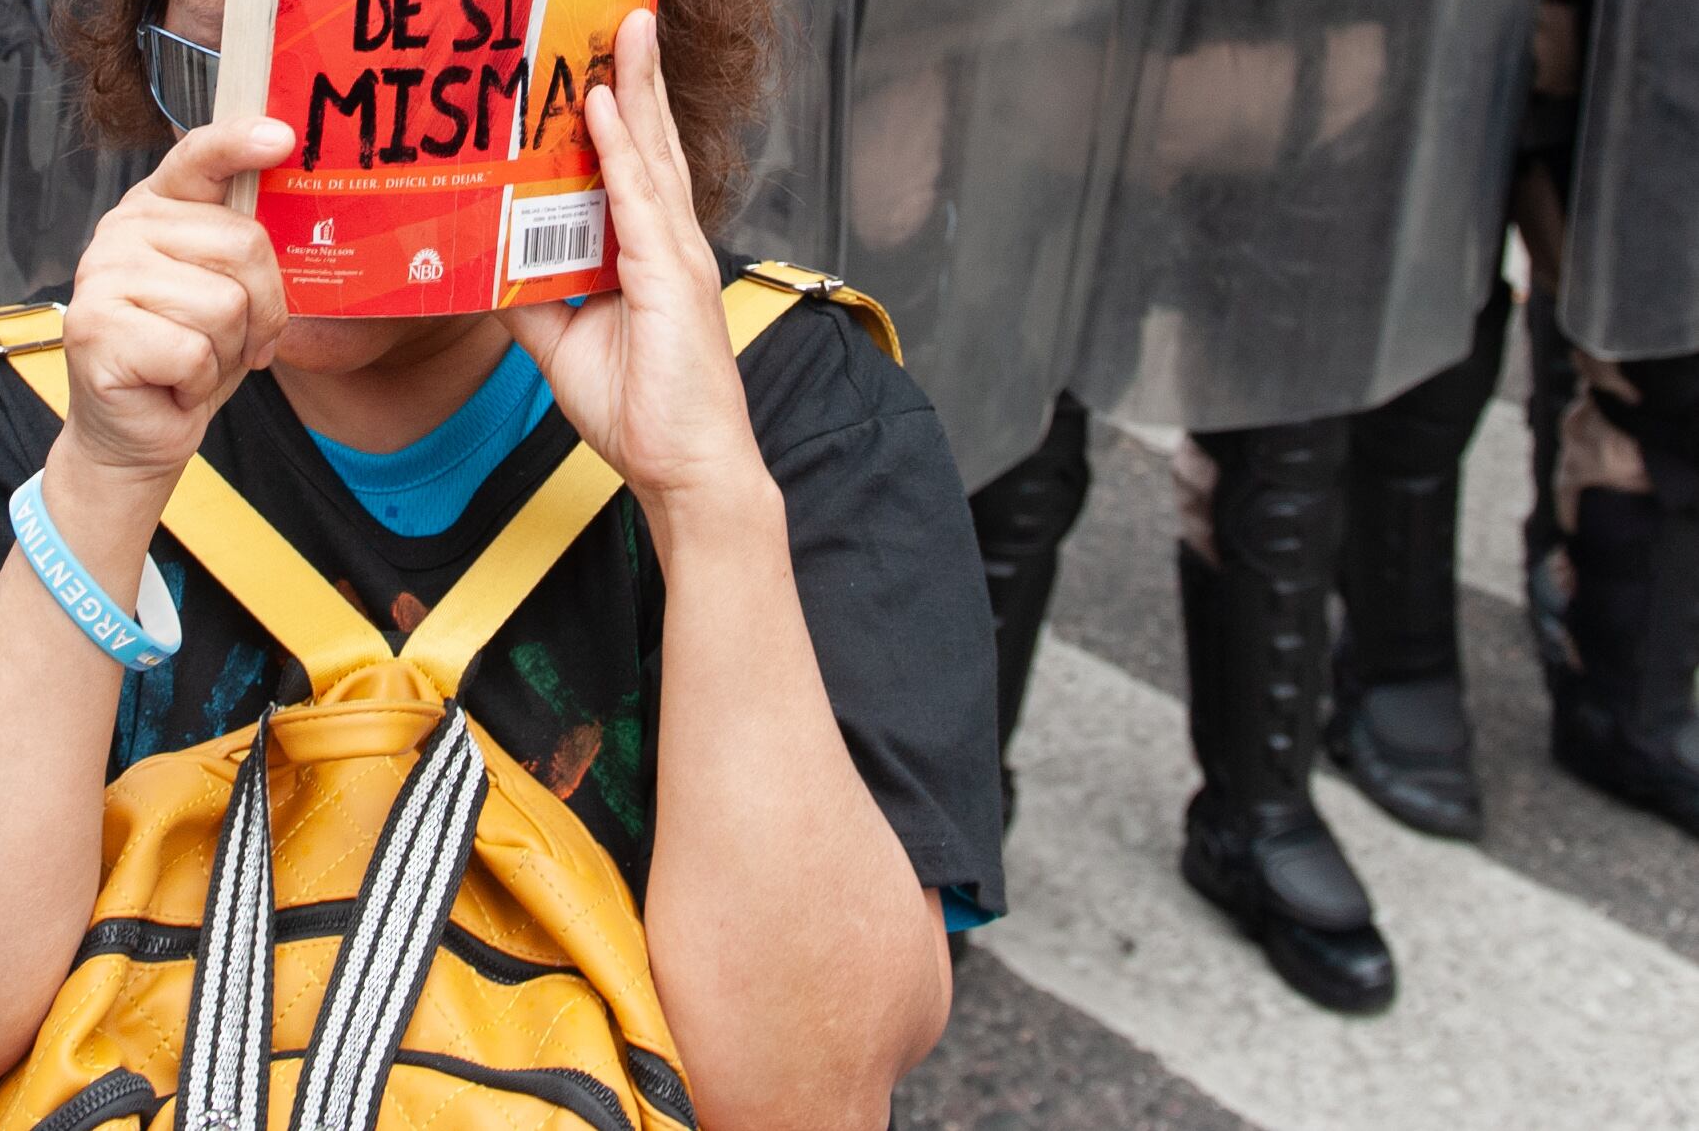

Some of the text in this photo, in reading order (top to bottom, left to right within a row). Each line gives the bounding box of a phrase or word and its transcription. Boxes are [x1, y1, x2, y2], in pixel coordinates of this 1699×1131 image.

[287, 176, 323, 190] FÁCIL
[328, 178, 344, 190] DE
[349, 178, 381, 190] LEER.
[385, 174, 427, 189] DIFÍCIL
[432, 174, 448, 187] DE
[408, 264, 444, 280] NBD
[15, 498, 138, 651] ARGENTINA
